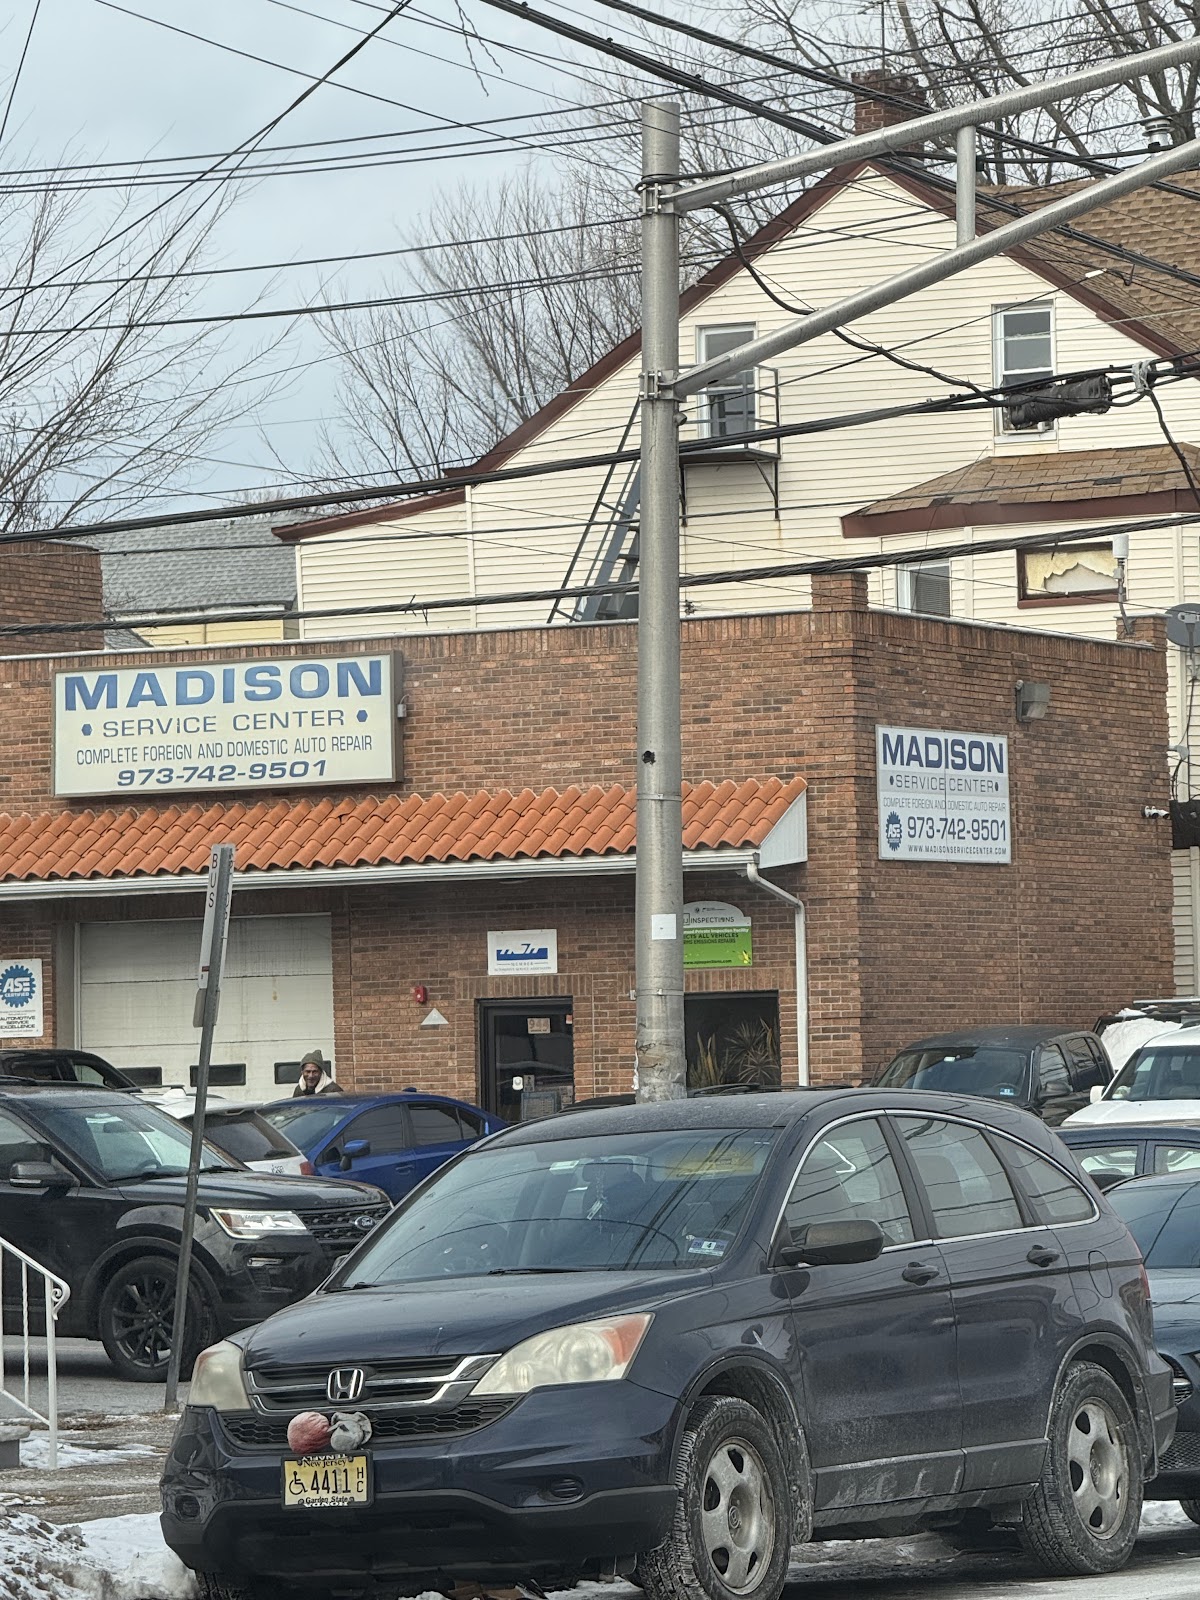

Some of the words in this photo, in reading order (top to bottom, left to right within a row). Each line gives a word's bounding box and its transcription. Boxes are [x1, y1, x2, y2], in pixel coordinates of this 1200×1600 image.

[65, 660, 381, 711] MADISON
[103, 715, 217, 738] SERVICE
[233, 709, 345, 731] CENTER
[77, 747, 138, 765] COMPLETE
[143, 745, 192, 762] FOREIGN
[198, 742, 223, 759] AND
[227, 739, 288, 757] DOMESTIC
[294, 737, 326, 754] AUTO
[332, 735, 372, 752] REPAIR
[882, 733, 1004, 773] MADISON
[117, 760, 327, 786] 973-742-9501
[896, 774, 945, 791] SERVICE
[950, 779, 994, 792] CENTER
[883, 797, 911, 808] COMPLETE
[912, 798, 934, 809] FOREIGN
[934, 800, 946, 810] AND
[948, 800, 973, 810] DOMESTIC
[974, 802, 988, 811] AUTO
[989, 802, 1006, 812] REPAIR
[886, 824, 900, 838] ASE
[907, 816, 1006, 842] 973-742-9501
[908, 844, 1006, 855] WWW.MADISONSERVICECENTER.COM
[208, 853, 218, 908] BUS
[3, 977, 30, 992] ASE
[322, 1459, 346, 1468] Jersey
[311, 1468, 350, 1494] 4411
